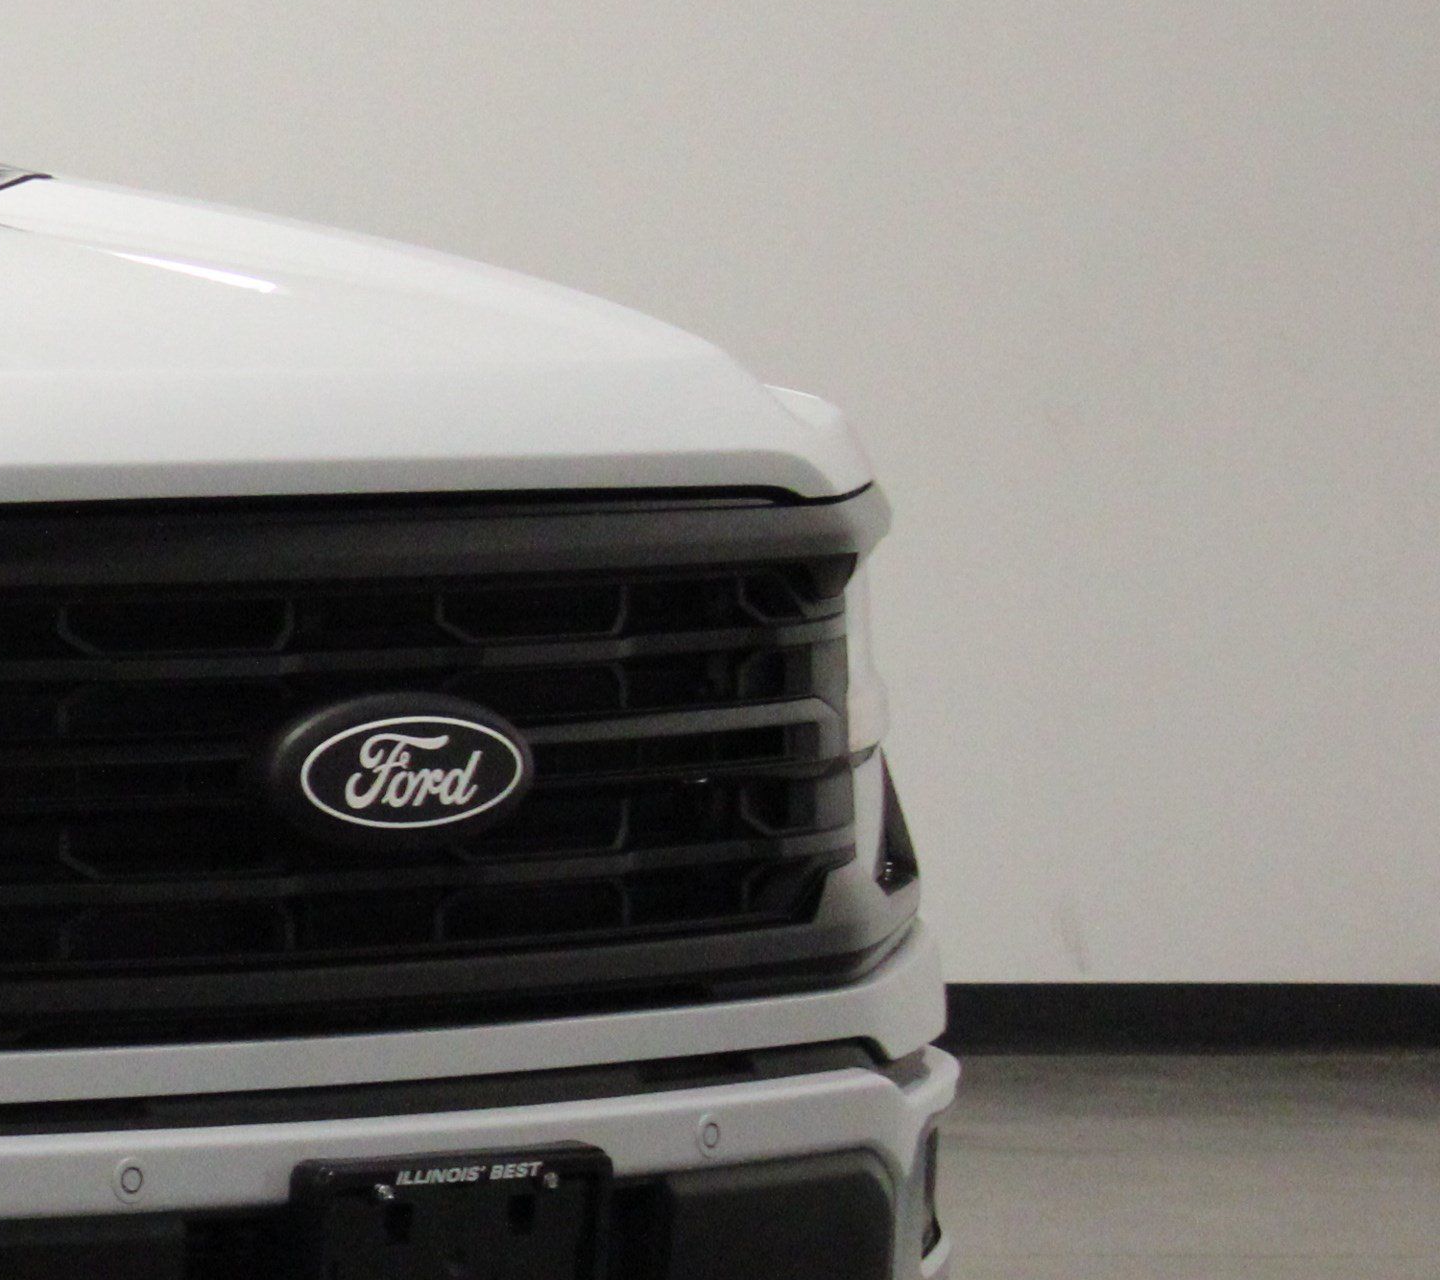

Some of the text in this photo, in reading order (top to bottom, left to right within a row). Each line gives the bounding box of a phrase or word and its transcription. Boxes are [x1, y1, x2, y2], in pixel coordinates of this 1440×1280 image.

[345, 732, 483, 809] Ford
[396, 1161, 542, 1186] ILLINOIS' BEST
